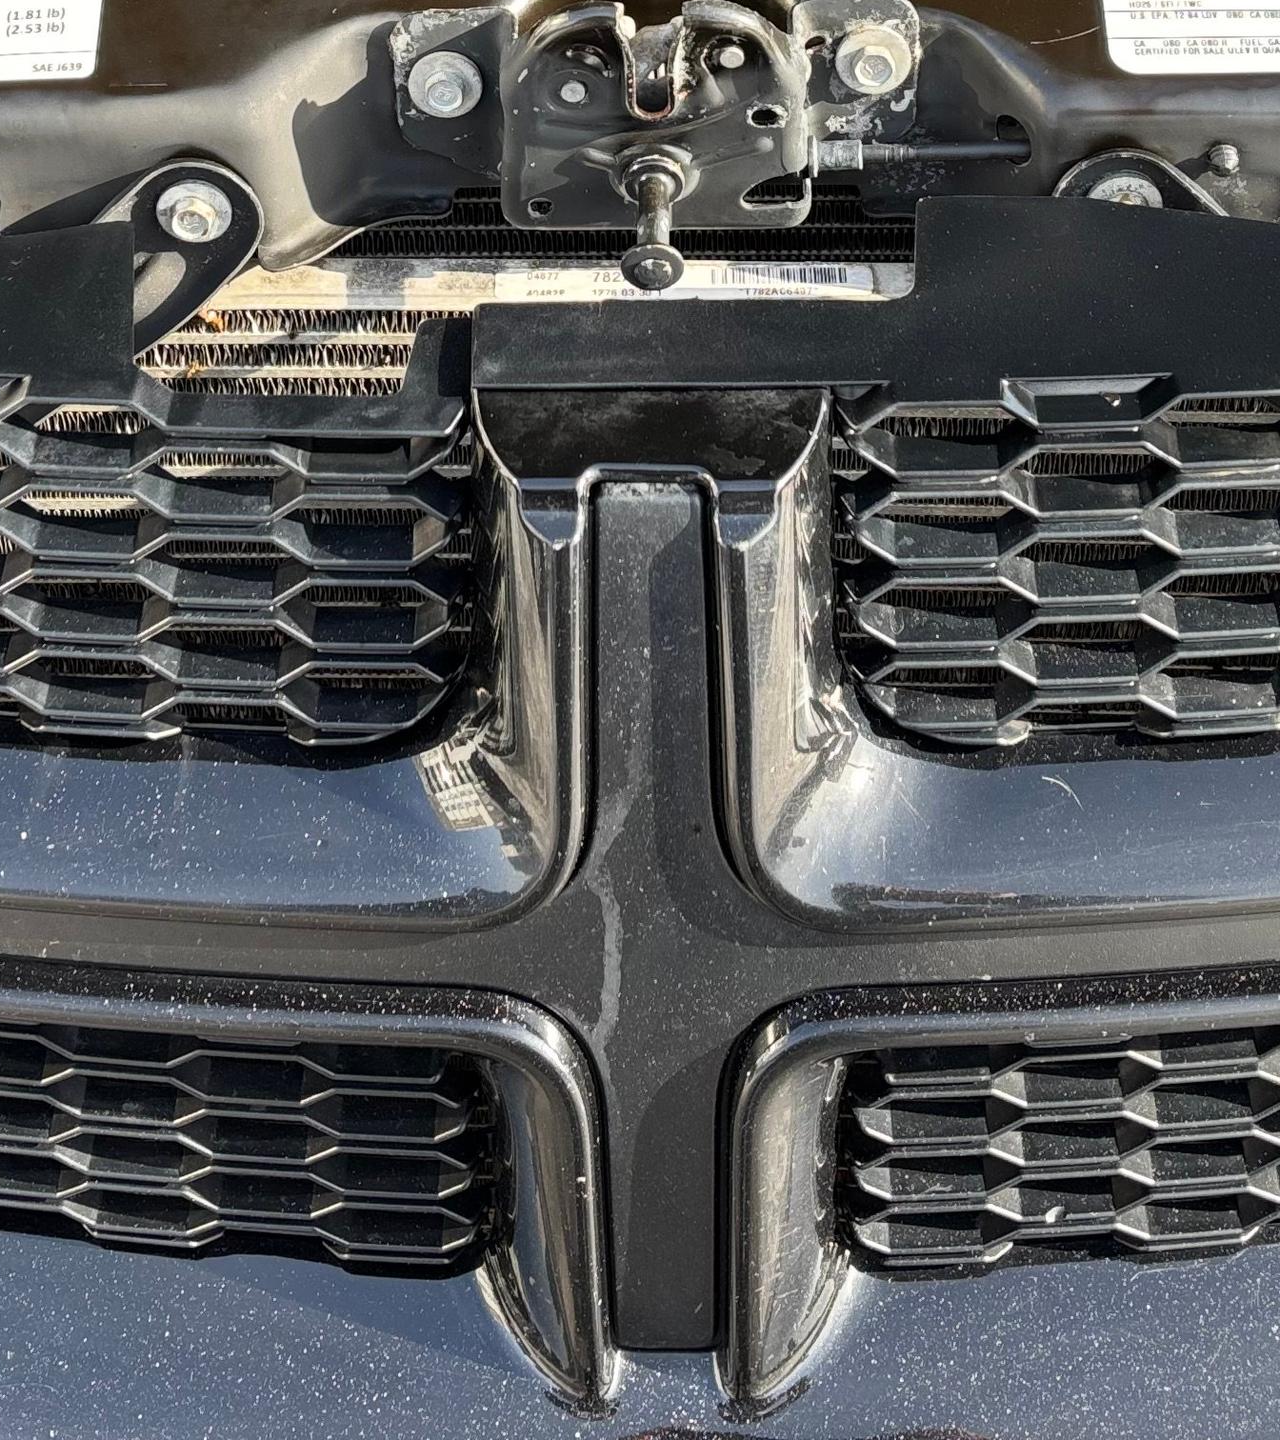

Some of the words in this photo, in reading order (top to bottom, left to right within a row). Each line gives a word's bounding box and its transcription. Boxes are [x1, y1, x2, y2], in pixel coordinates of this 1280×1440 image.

[6, 9, 43, 23] (1.81
[46, 7, 66, 21] lb)
[5, 23, 43, 38] (2.53
[46, 21, 66, 35] lb)
[1134, 47, 1180, 56] CERTIFIED
[1183, 47, 1200, 55] FOR
[1203, 47, 1224, 55] SALE
[32, 63, 54, 73] SAE
